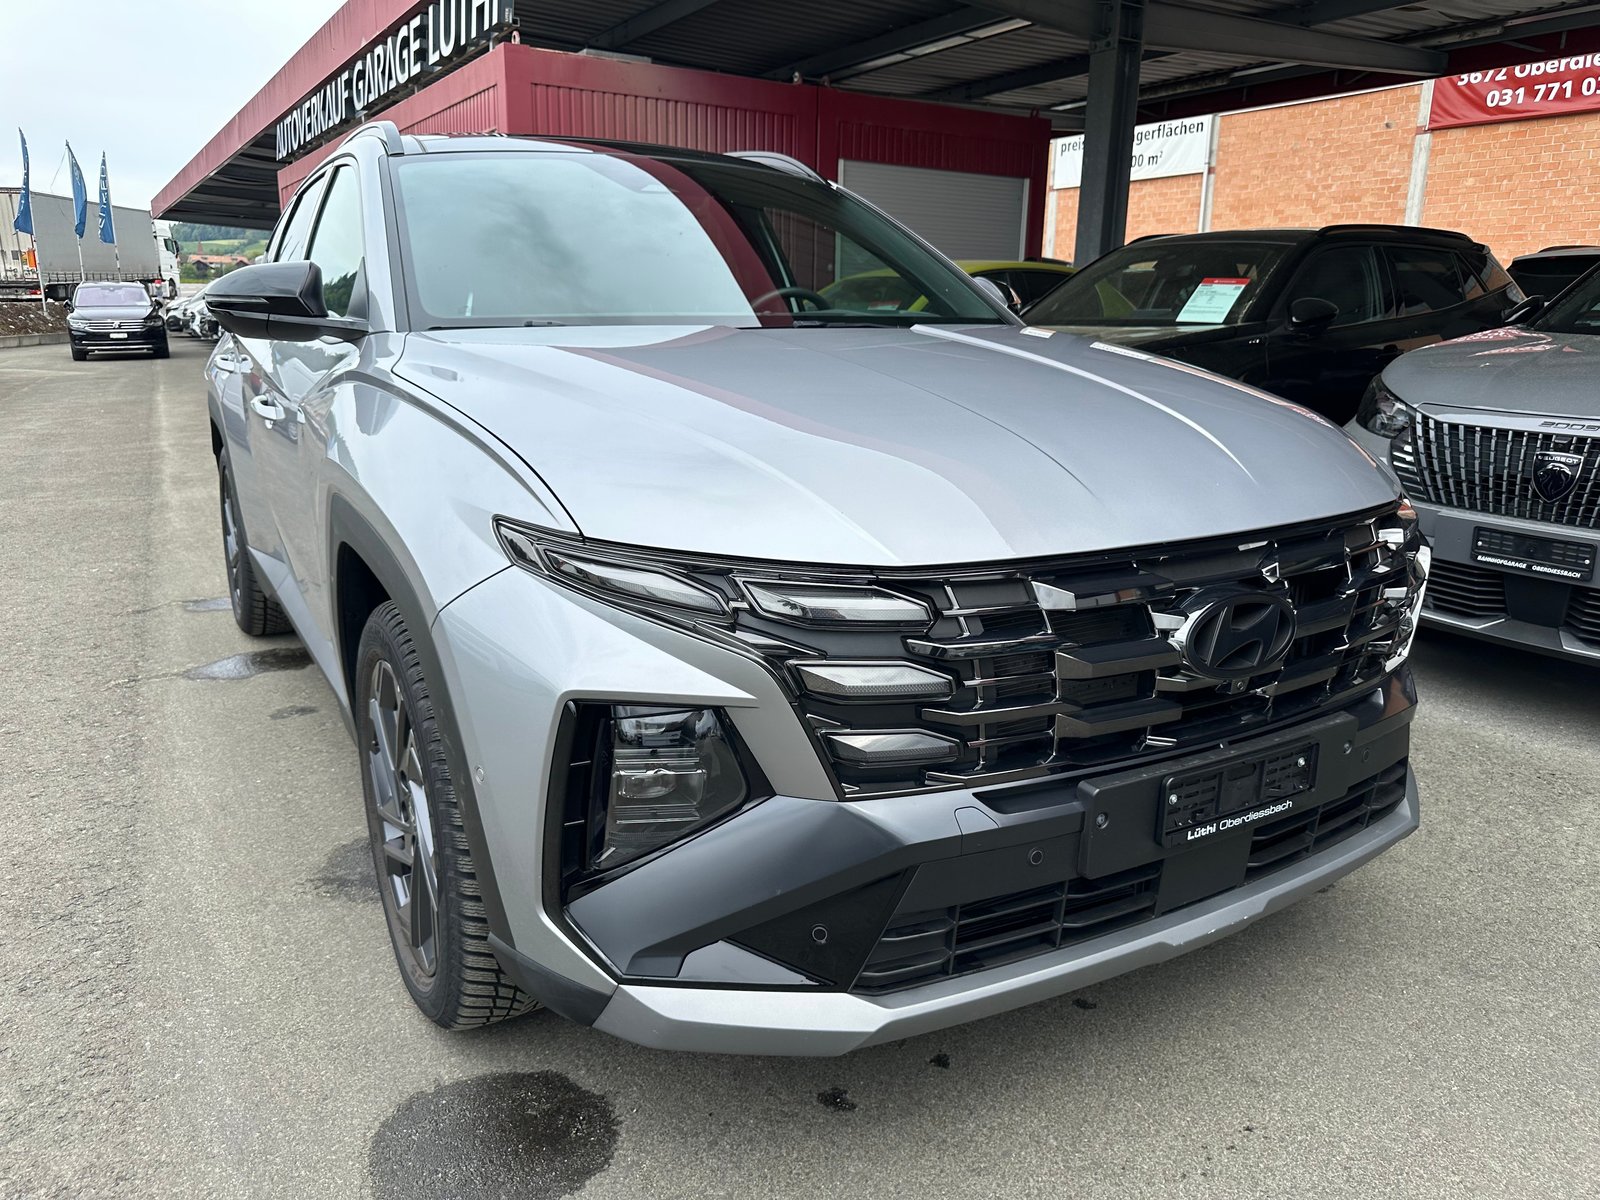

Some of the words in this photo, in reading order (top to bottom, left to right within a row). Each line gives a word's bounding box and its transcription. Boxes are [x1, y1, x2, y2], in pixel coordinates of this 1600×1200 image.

[276, 70, 349, 161] AUTOVERKAUF
[352, 14, 421, 111] GARAGE
[1457, 68, 1507, 86] 3672
[1486, 87, 1525, 107] 031
[1534, 80, 1573, 102] 771
[1134, 121, 1204, 146] gerflächen
[1537, 455, 1580, 465] PEUGEOT
[1531, 565, 1581, 578] OBERDIESSBACH
[1219, 800, 1293, 830] Oberdiessbach
